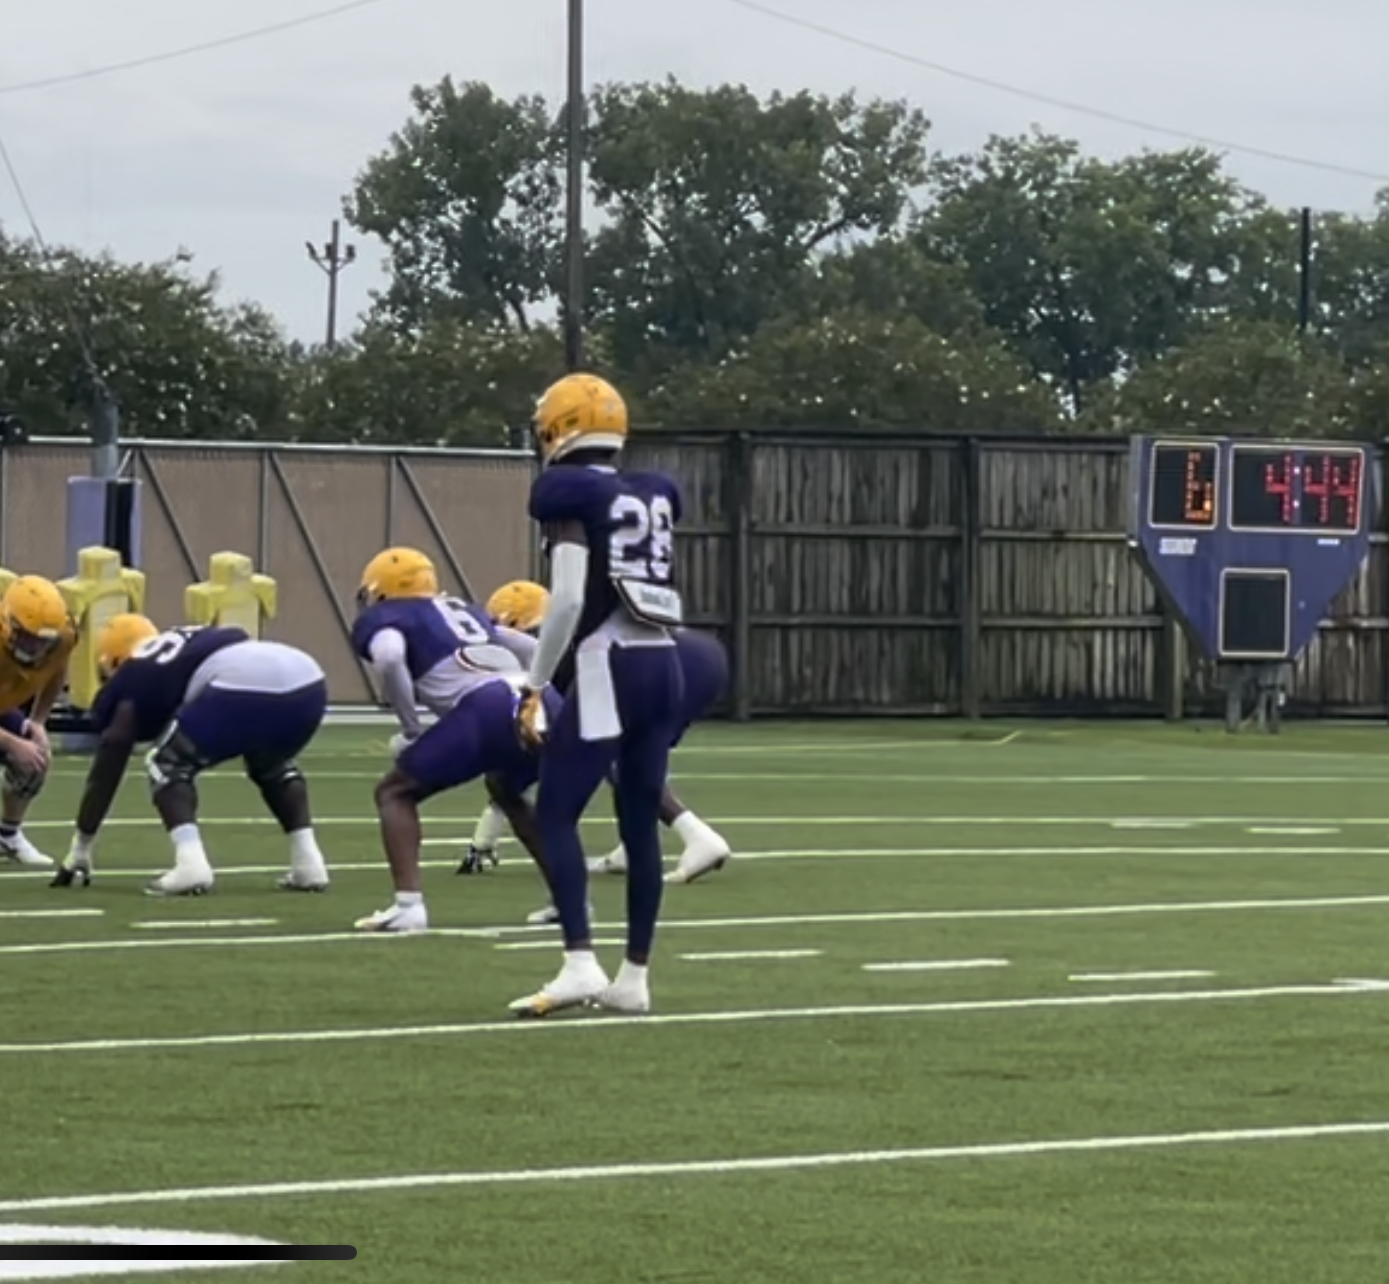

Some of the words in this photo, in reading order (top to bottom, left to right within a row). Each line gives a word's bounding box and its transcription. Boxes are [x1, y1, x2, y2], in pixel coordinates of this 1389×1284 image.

[1266, 454, 1358, 525] 4:44
[610, 494, 674, 579] 28
[432, 596, 490, 644] 6
